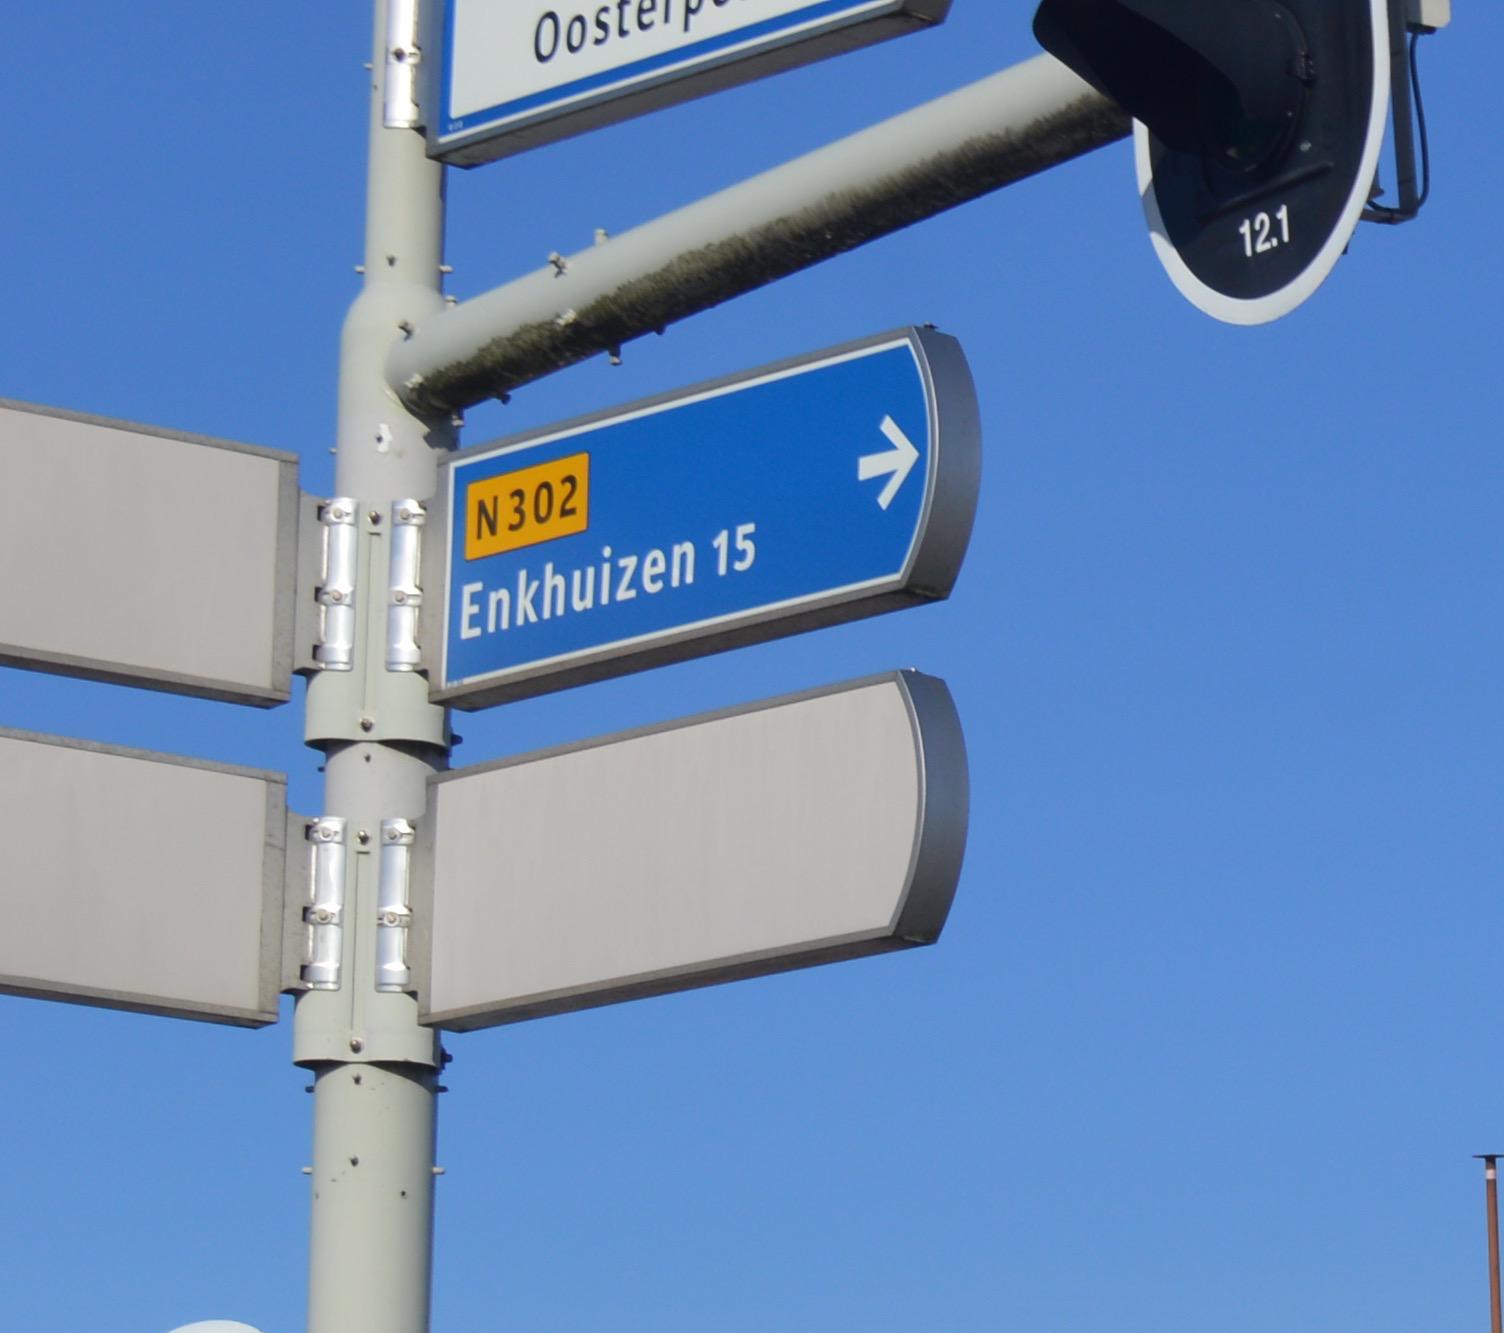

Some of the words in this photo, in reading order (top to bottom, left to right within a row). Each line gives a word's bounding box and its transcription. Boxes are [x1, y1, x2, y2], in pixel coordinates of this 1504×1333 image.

[1239, 204, 1289, 257] 12.1
[476, 474, 578, 540] N302
[460, 541, 695, 640] Enkhuizen
[712, 522, 756, 576] 15
